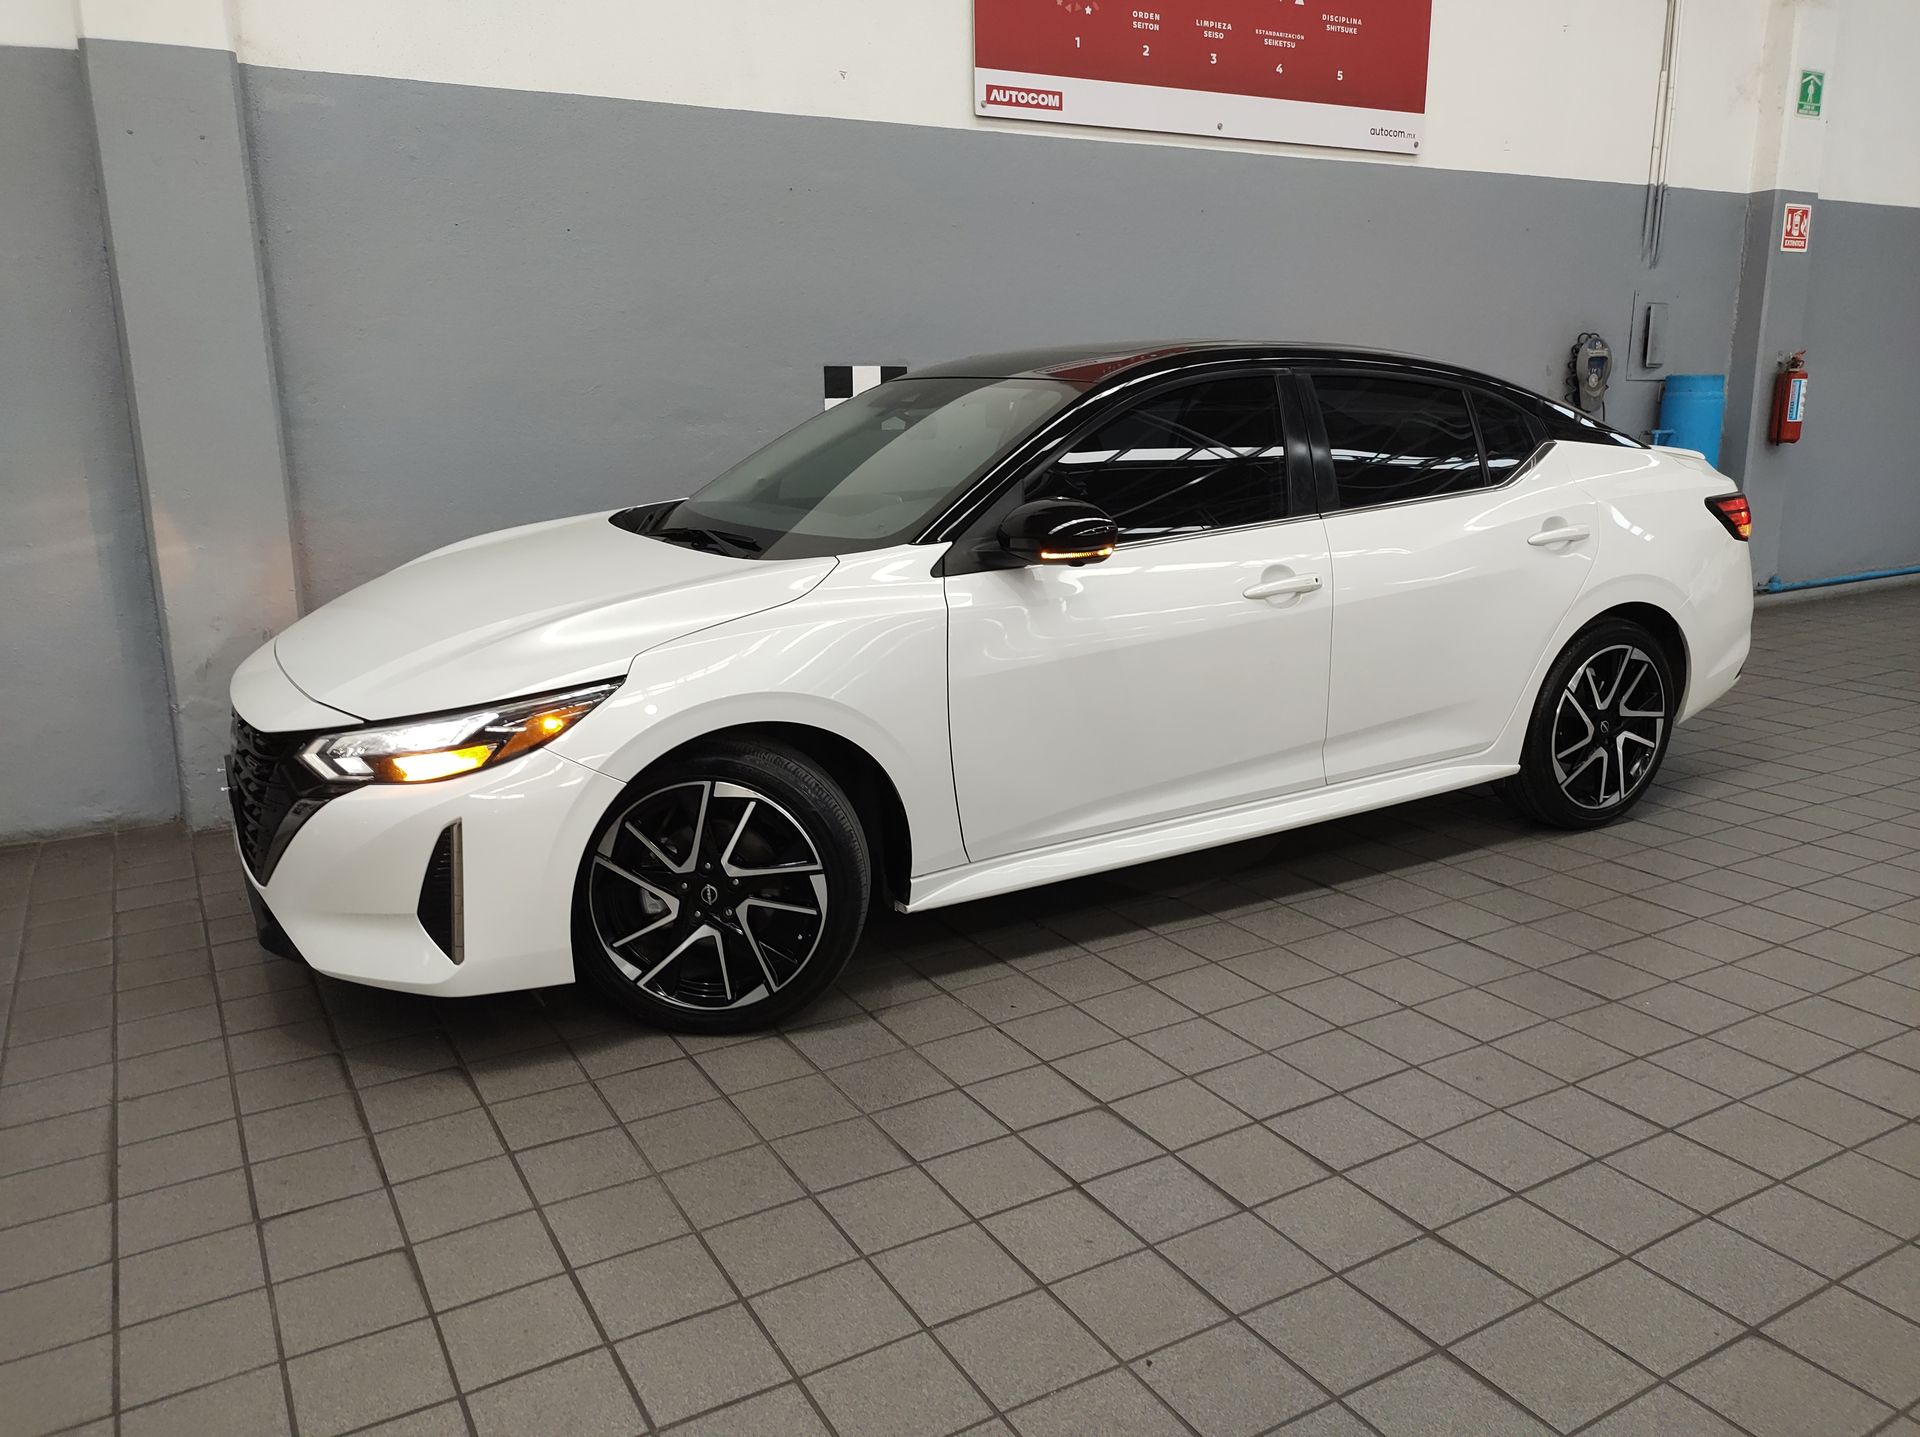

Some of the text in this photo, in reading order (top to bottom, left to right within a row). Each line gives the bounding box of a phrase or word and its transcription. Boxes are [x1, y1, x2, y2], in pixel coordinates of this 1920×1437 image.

[1132, 10, 1161, 21] ORDEN
[1322, 13, 1362, 26] DISCIPLINA
[1132, 21, 1160, 31] SEITON
[1195, 19, 1232, 31] LIMPIEZA
[1326, 24, 1358, 35] SHITSUKE
[1203, 30, 1224, 40] SEISO
[1075, 37, 1081, 49] 1
[1264, 38, 1296, 49] SEIKETSU
[1142, 45, 1150, 57] 2
[1210, 53, 1217, 65] 3
[1275, 63, 1283, 74] 4
[1337, 70, 1344, 81] 5
[990, 88, 1060, 107] AUTOCOM
